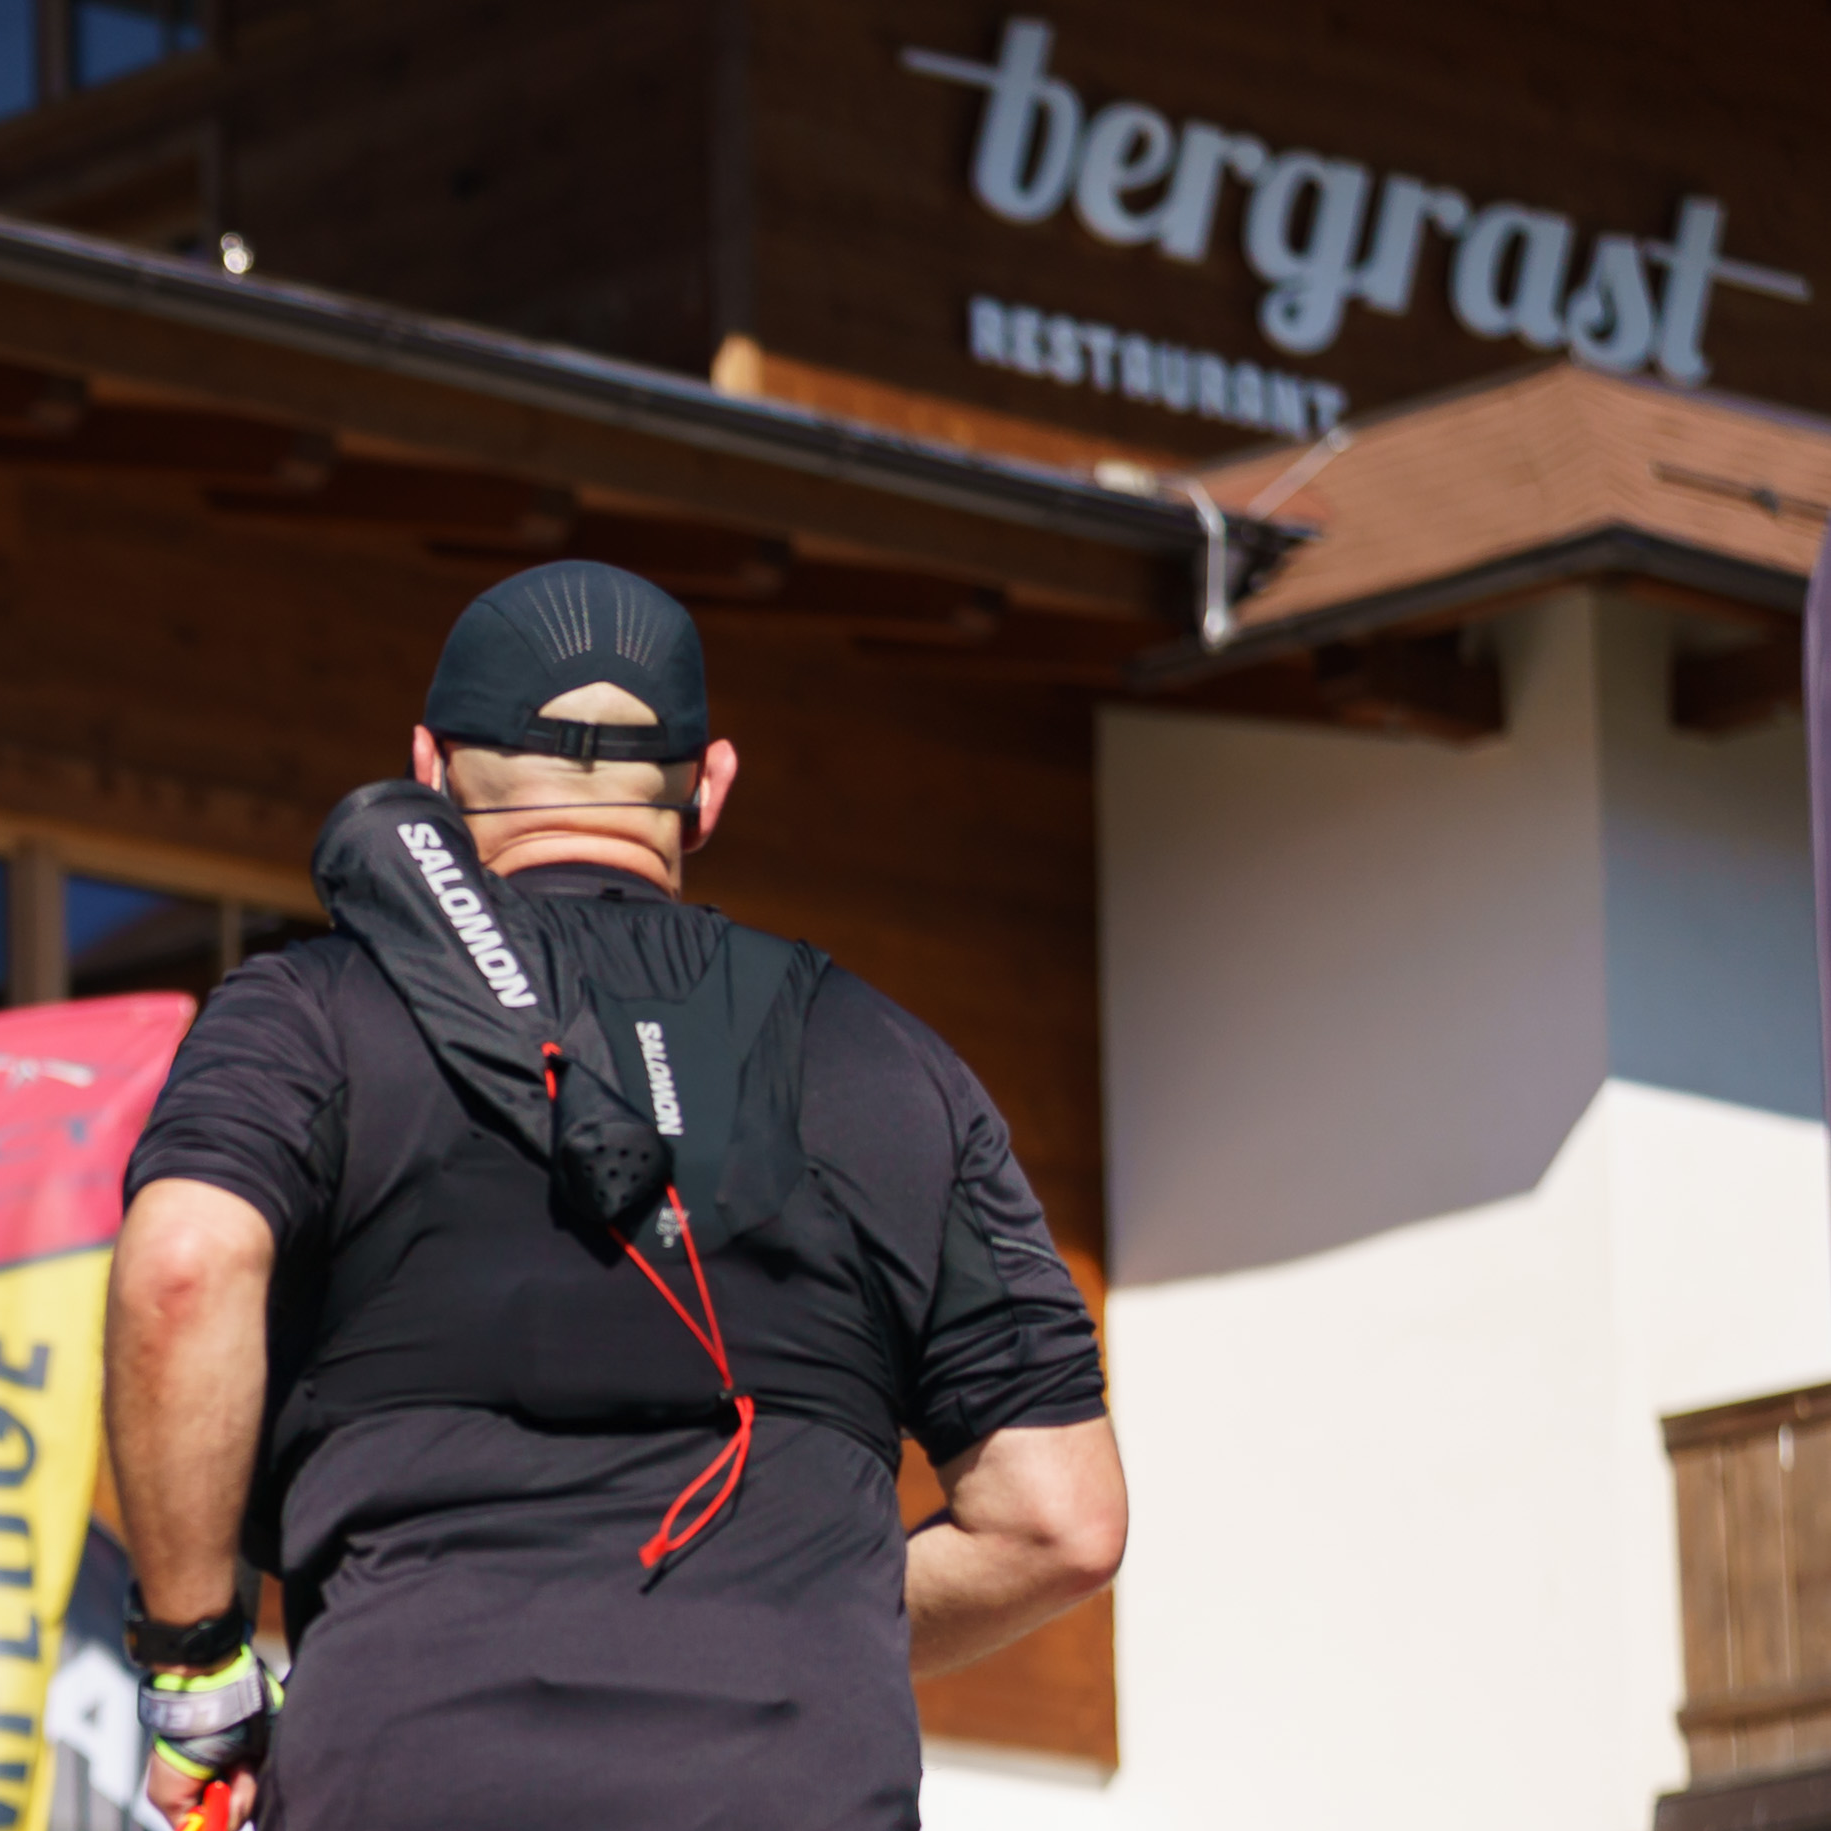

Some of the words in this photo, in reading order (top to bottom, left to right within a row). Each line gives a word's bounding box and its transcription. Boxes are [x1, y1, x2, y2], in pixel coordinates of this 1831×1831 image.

[898, 17, 1812, 388] bergrast
[966, 297, 1347, 438] RESTAURANT
[397, 822, 538, 1009] SALOMON
[635, 1020, 685, 1136] SALOMON
